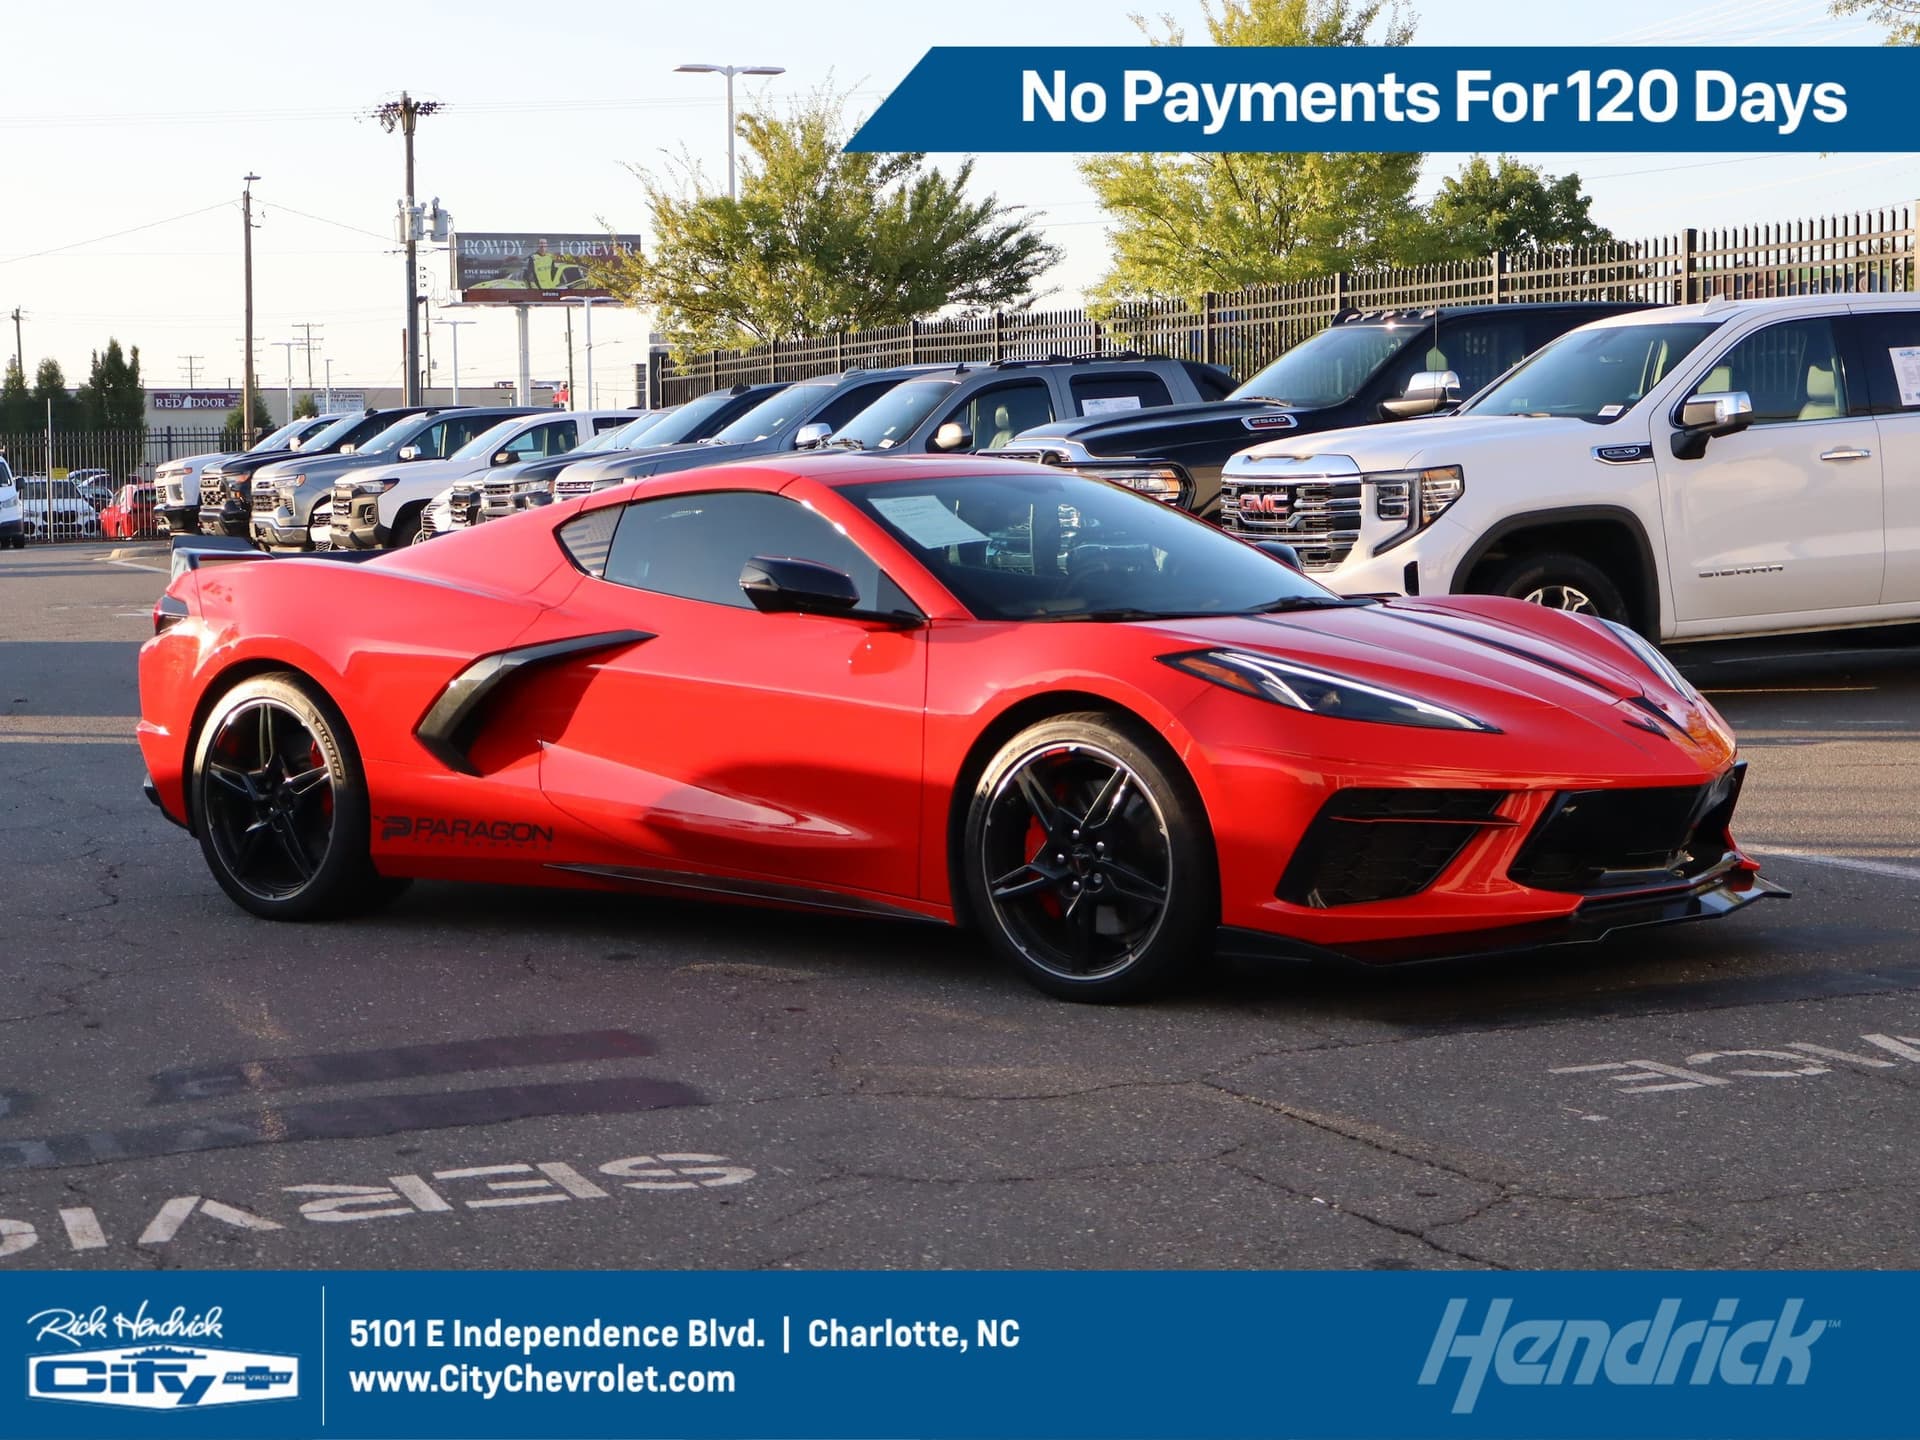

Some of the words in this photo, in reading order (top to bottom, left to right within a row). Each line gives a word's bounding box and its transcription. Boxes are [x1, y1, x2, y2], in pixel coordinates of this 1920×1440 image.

[464, 239, 526, 256] ROWDY
[155, 398, 181, 408] RED
[192, 398, 225, 408] DOOR
[1239, 494, 1289, 513] GMC
[315, 719, 343, 778] MICHELIN
[414, 817, 555, 842] PARAGON
